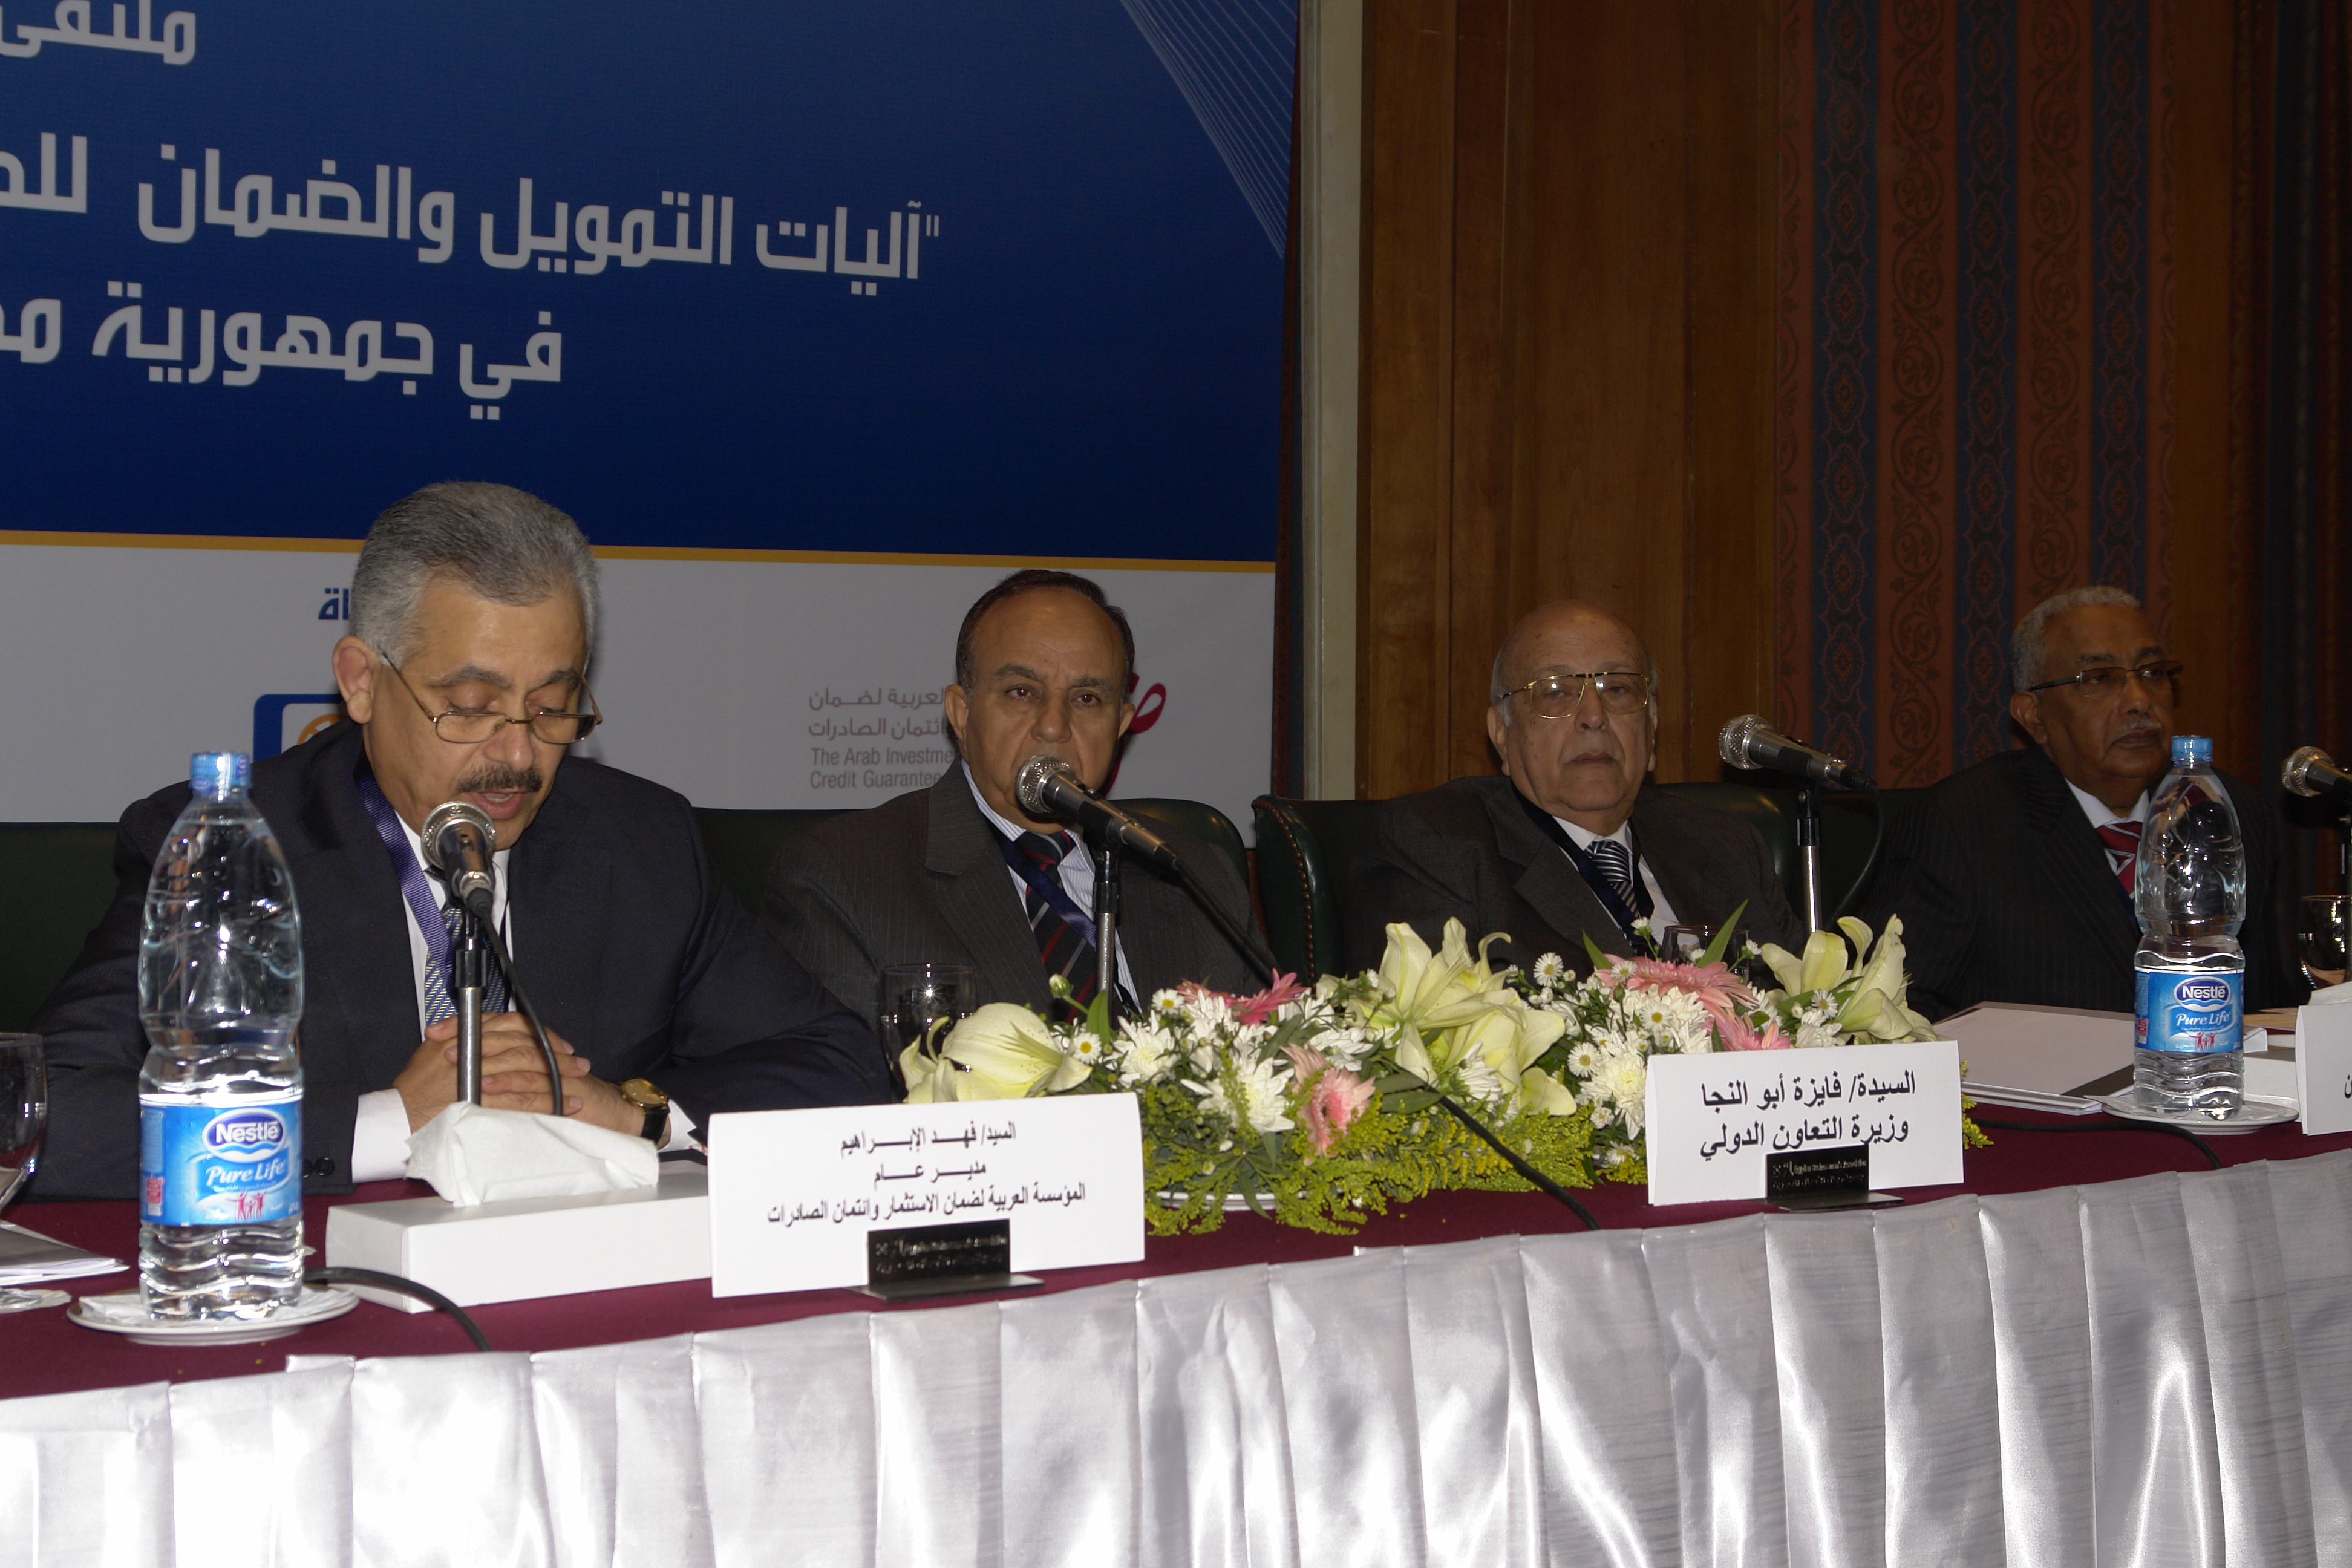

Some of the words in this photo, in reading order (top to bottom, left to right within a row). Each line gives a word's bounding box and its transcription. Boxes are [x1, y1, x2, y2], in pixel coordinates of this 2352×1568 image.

[138, 143, 454, 263] والضمان
[480, 177, 733, 275] التمويل
[91, 281, 434, 395] جمهورية
[459, 311, 562, 420] في
[809, 687, 882, 711] لضمان
[887, 687, 944, 710] لعربية
[808, 717, 886, 742] الصادرات
[890, 717, 945, 741] ائتمان
[811, 748, 839, 765] The
[844, 748, 880, 765] Arab
[886, 747, 953, 765] Investme
[811, 770, 856, 788] Credit
[863, 770, 941, 788] Guarantee
[2181, 984, 2226, 999] Nestlé
[2176, 1013, 2207, 1027] Pure
[2209, 1011, 2230, 1025] Life
[1701, 1080, 1748, 1114] النجا
[1757, 1073, 1785, 1111] أبو
[1793, 1071, 1842, 1108] فايزة
[1848, 1070, 1915, 1103] السيدة/
[215, 1120, 279, 1143] Nestlé
[1700, 1122, 1765, 1161] الدولي
[1772, 1115, 1843, 1151] التعاون
[1851, 1114, 1909, 1144] وزيرة
[206, 1165, 253, 1186] Pure
[255, 1157, 284, 1181] Life
[944, 1189, 984, 1215] لضمان
[988, 1184, 1028, 1212] العربية
[1033, 1181, 1086, 1207] المؤسسة
[767, 1200, 828, 1227] الصادرات
